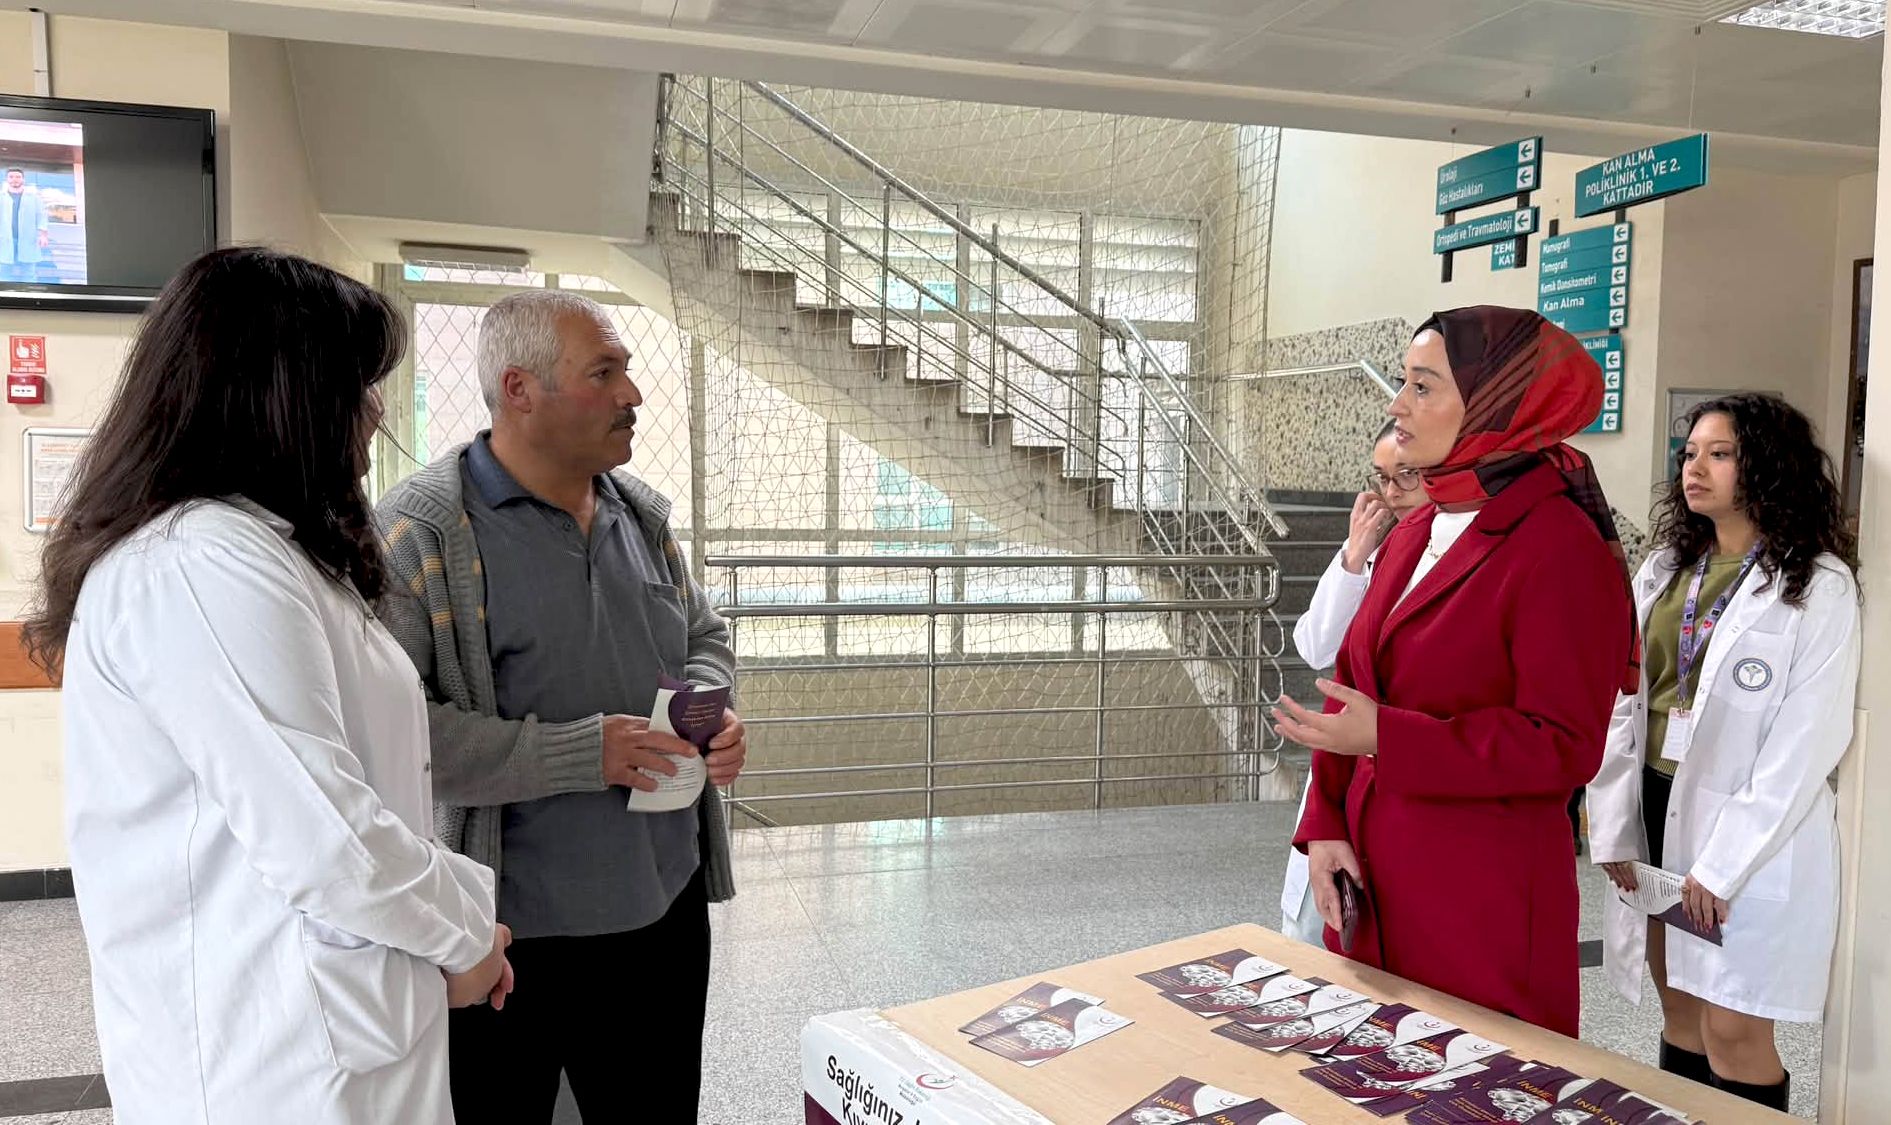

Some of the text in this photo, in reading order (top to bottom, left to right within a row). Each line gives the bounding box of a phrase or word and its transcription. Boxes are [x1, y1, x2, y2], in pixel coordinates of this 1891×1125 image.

[1602, 147, 1656, 177] KAN ALMA
[1585, 158, 1681, 198] POLİKLİNİK 1. VE 2.
[1602, 180, 1654, 206] KATTADIR
[1467, 215, 1513, 239] Travmatoloji
[1543, 296, 1585, 313] Kan Alma
[826, 1054, 904, 1125] Sağlığınız
